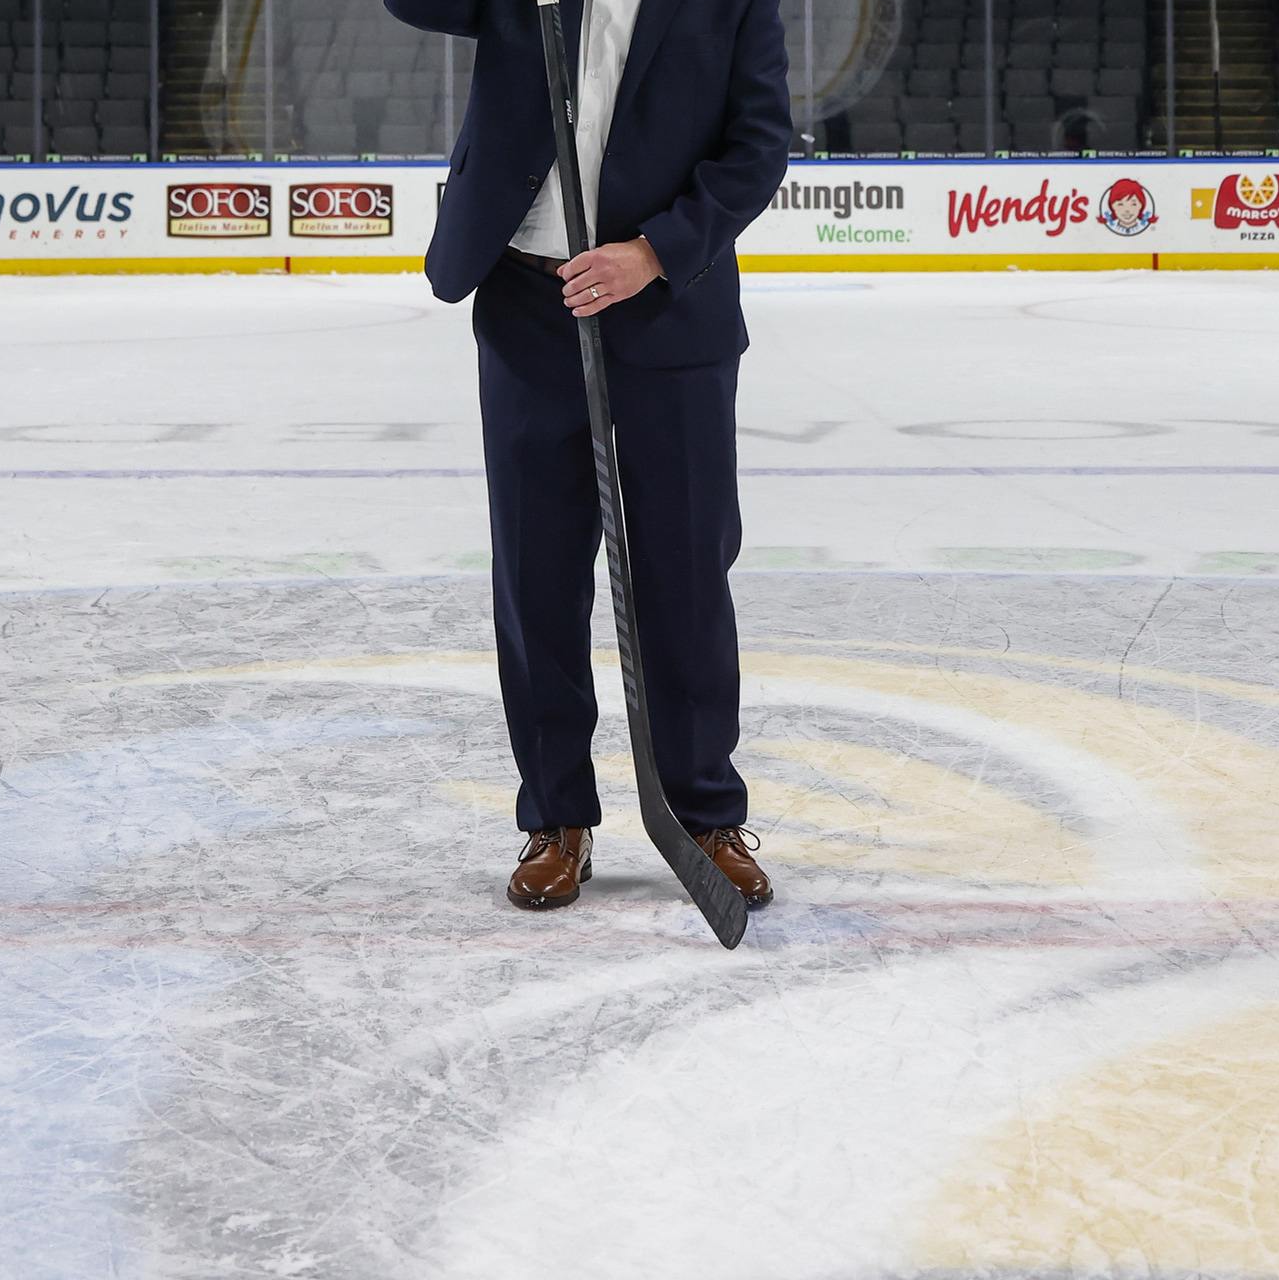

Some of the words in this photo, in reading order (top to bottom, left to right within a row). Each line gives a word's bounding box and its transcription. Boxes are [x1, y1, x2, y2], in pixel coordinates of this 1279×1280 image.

[169, 187, 270, 217] SOFO's
[291, 187, 391, 217] SOFO's
[771, 180, 904, 220] ntington
[948, 178, 1089, 238] Wendy's
[8, 230, 129, 240] ENERGY
[177, 221, 217, 231] Italian
[222, 221, 262, 232] Market
[300, 221, 332, 231] Italian
[344, 221, 383, 231] Market
[1239, 232, 1275, 241] PIZZA
[589, 437, 640, 713] WARRIOR
